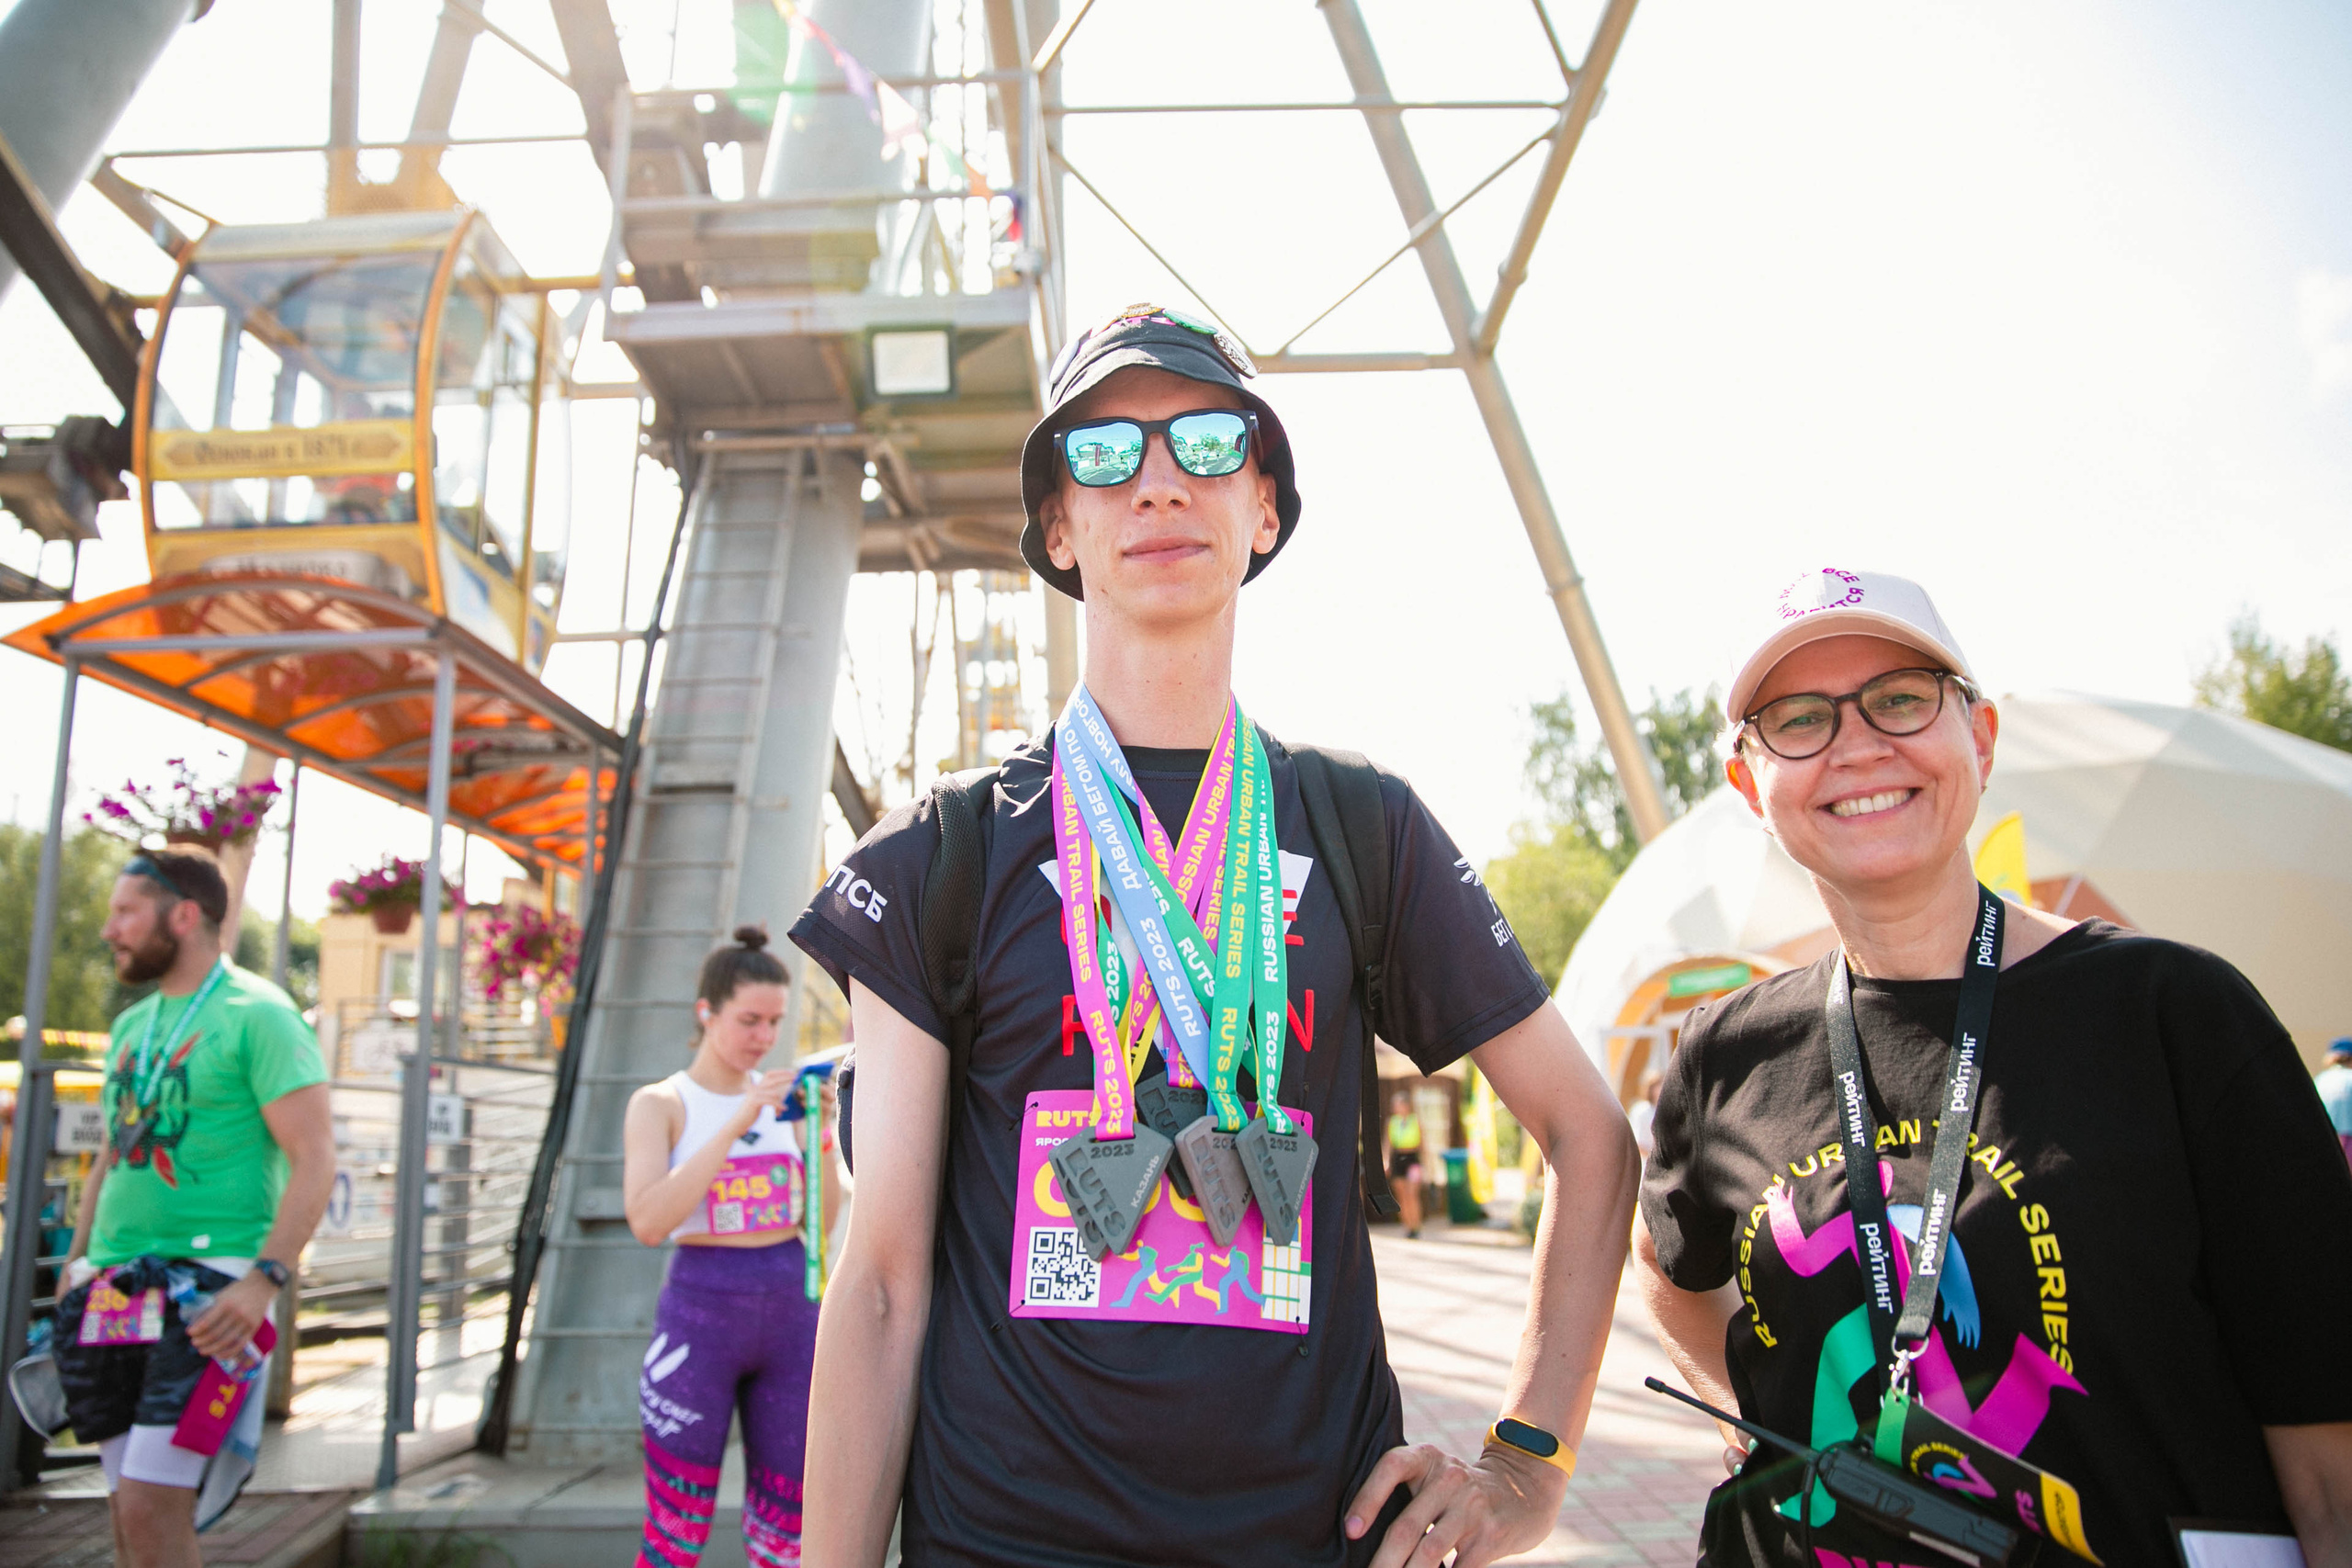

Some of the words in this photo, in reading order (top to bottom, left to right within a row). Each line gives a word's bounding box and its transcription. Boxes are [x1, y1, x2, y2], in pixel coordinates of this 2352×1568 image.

[1064, 728, 1081, 755] ПО
[1072, 754, 1108, 817] БЕГОМ
[1238, 769, 1254, 837] URBAN
[1095, 818, 1142, 890] ДАВАЙ
[1175, 827, 1212, 903] USSIAN
[1202, 761, 1233, 826] URBAN
[825, 864, 888, 923] ПСБ
[1067, 838, 1084, 903] TRAIL
[1232, 840, 1250, 898] TRAIL
[1204, 865, 1226, 941] SERIES
[1261, 885, 1278, 982] RUSSIAN
[1976, 900, 1996, 967] рейтинг
[1073, 903, 1091, 983] SERIES
[1105, 941, 1120, 1001] 2023
[1140, 917, 1174, 971] 2023
[1178, 937, 1216, 998] RUTS
[1226, 902, 1246, 978] SERIES
[1166, 975, 1201, 1037] RUTS
[1089, 1010, 1116, 1075] RUTS
[1217, 1007, 1238, 1073] RUTS
[1266, 1011, 1279, 1070] 2023
[1950, 1032, 1976, 1111] рейтинг
[1104, 1077, 1124, 1134] 2023
[1216, 1077, 1239, 1131] 2023
[1266, 1074, 1287, 1134] RUTS
[1838, 1070, 1866, 1147] рейтинг
[1090, 1143, 1135, 1159] 2023
[1270, 1136, 1298, 1153] 2023
[711, 1175, 772, 1202] 145
[1065, 1147, 1125, 1237] RUTS
[1130, 1155, 1159, 1209] КАЗАНЬ
[1191, 1134, 1236, 1229] RUTS
[1252, 1134, 1295, 1228] RUTS
[1788, 1118, 1921, 1178] URAN
[1932, 1118, 2025, 1201] AIL
[2019, 1202, 2075, 1376] SERIES
[1918, 1188, 1947, 1276] рейтинг
[1860, 1222, 1893, 1314] рейтинг
